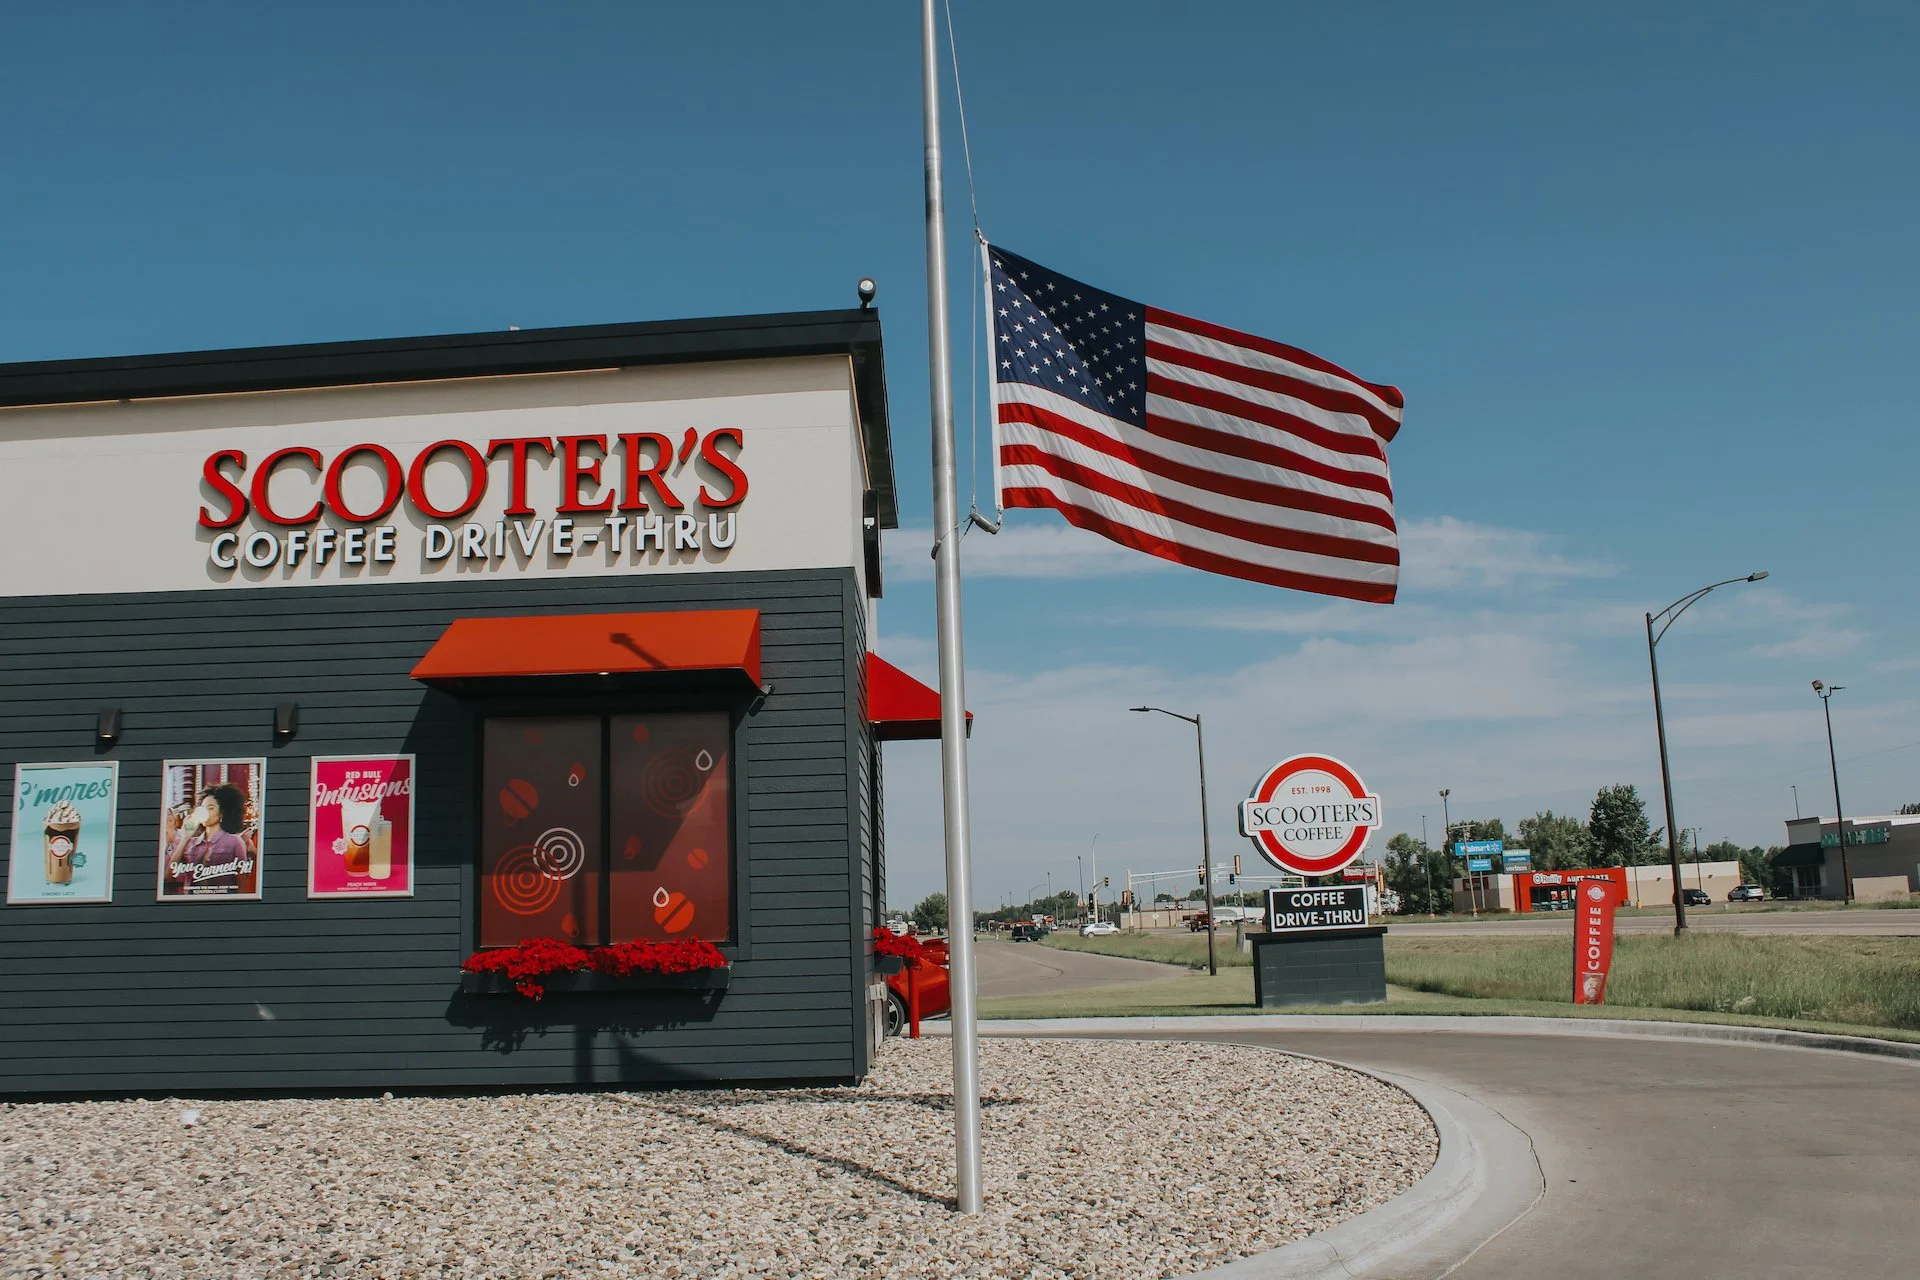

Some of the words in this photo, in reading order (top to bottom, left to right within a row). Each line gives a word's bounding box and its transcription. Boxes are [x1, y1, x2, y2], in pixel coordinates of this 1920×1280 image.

[199, 427, 749, 528] SCOOTER'S
[210, 526, 396, 569] COFFEE
[425, 512, 737, 560] DRIVE-THRU
[345, 771, 361, 779] RED
[362, 770, 381, 779] BULL
[316, 777, 411, 808] Infusions
[1291, 787, 1308, 795] EST.
[1311, 786, 1331, 794] 1998
[1253, 803, 1373, 826] SCOOTER'S
[1283, 827, 1344, 842] COFFEE
[1460, 844, 1490, 853] Walmart
[170, 861, 195, 878] You
[193, 858, 239, 882] Earned
[237, 860, 254, 874] It!
[1533, 873, 1562, 885] O'Reilly
[1291, 892, 1345, 907] COFFEE
[1276, 909, 1364, 927] DRIVE-THRU
[1587, 907, 1602, 971] COFFEE
